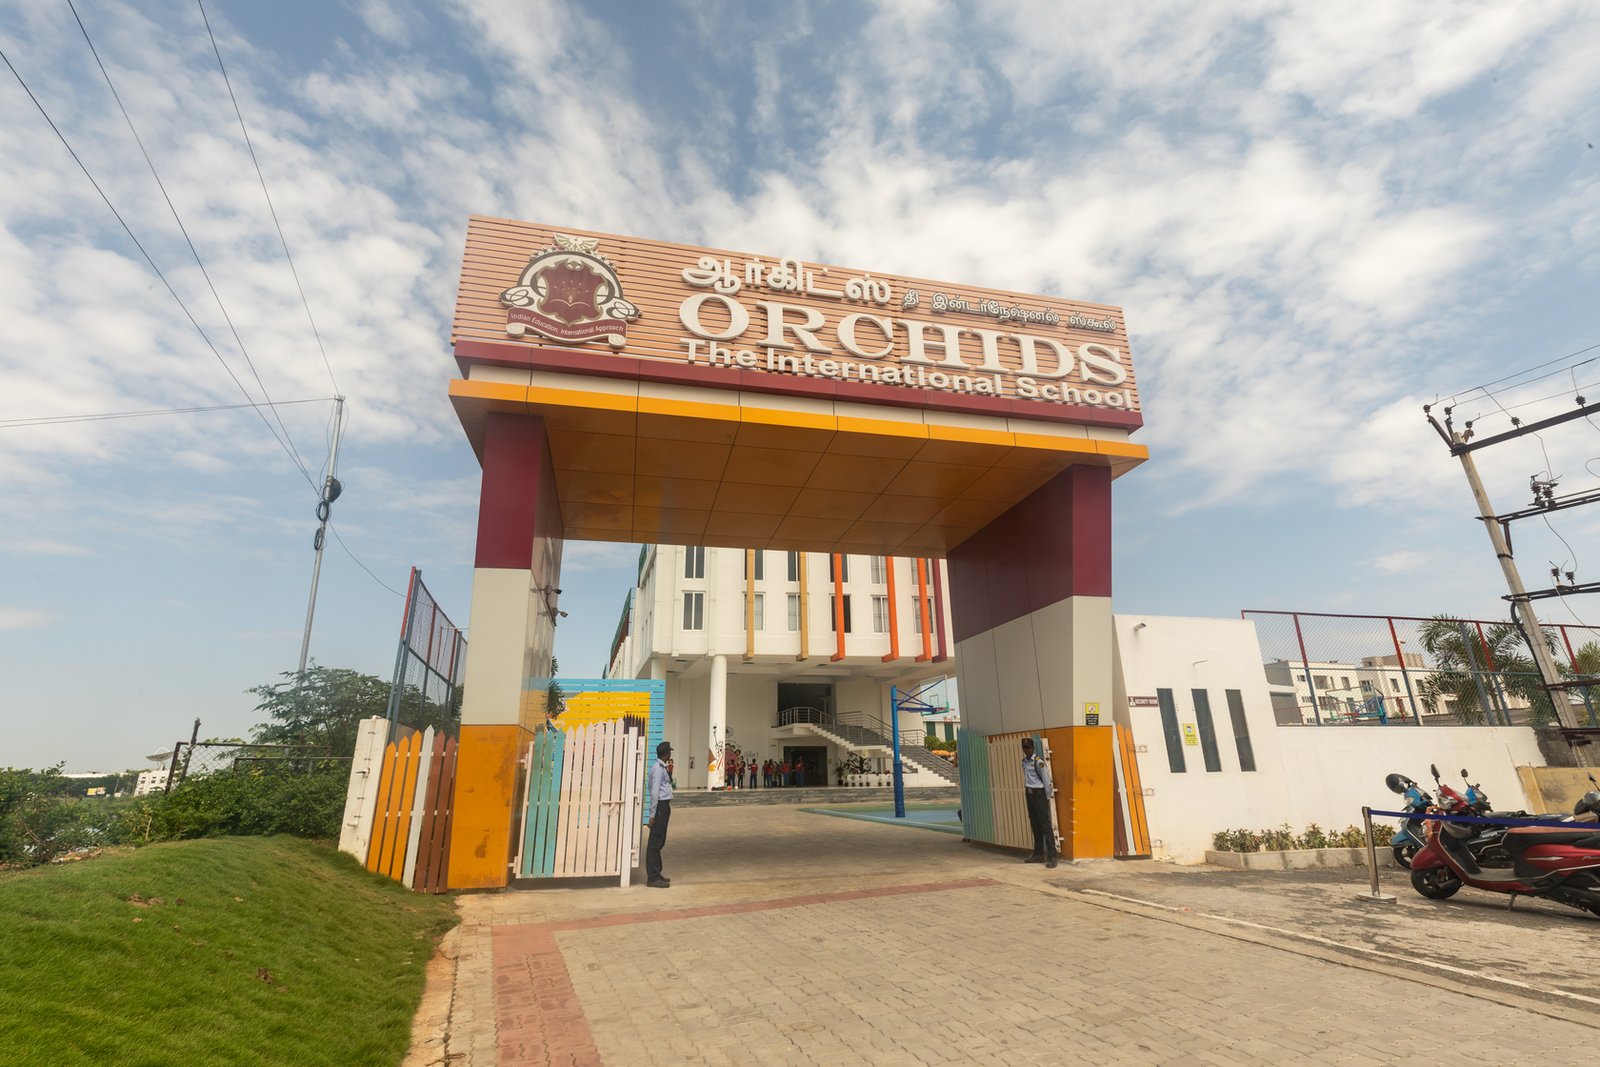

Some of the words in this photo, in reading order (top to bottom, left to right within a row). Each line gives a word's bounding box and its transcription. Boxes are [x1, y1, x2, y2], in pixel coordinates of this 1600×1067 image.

[681, 256, 892, 305] ஆர்கிட்ஸ்
[510, 312, 531, 322] Indian
[560, 327, 595, 336] International
[679, 292, 1127, 386] ORCHIDS
[680, 338, 758, 369] The
[767, 348, 1003, 398] International
[1015, 376, 1134, 411] School
